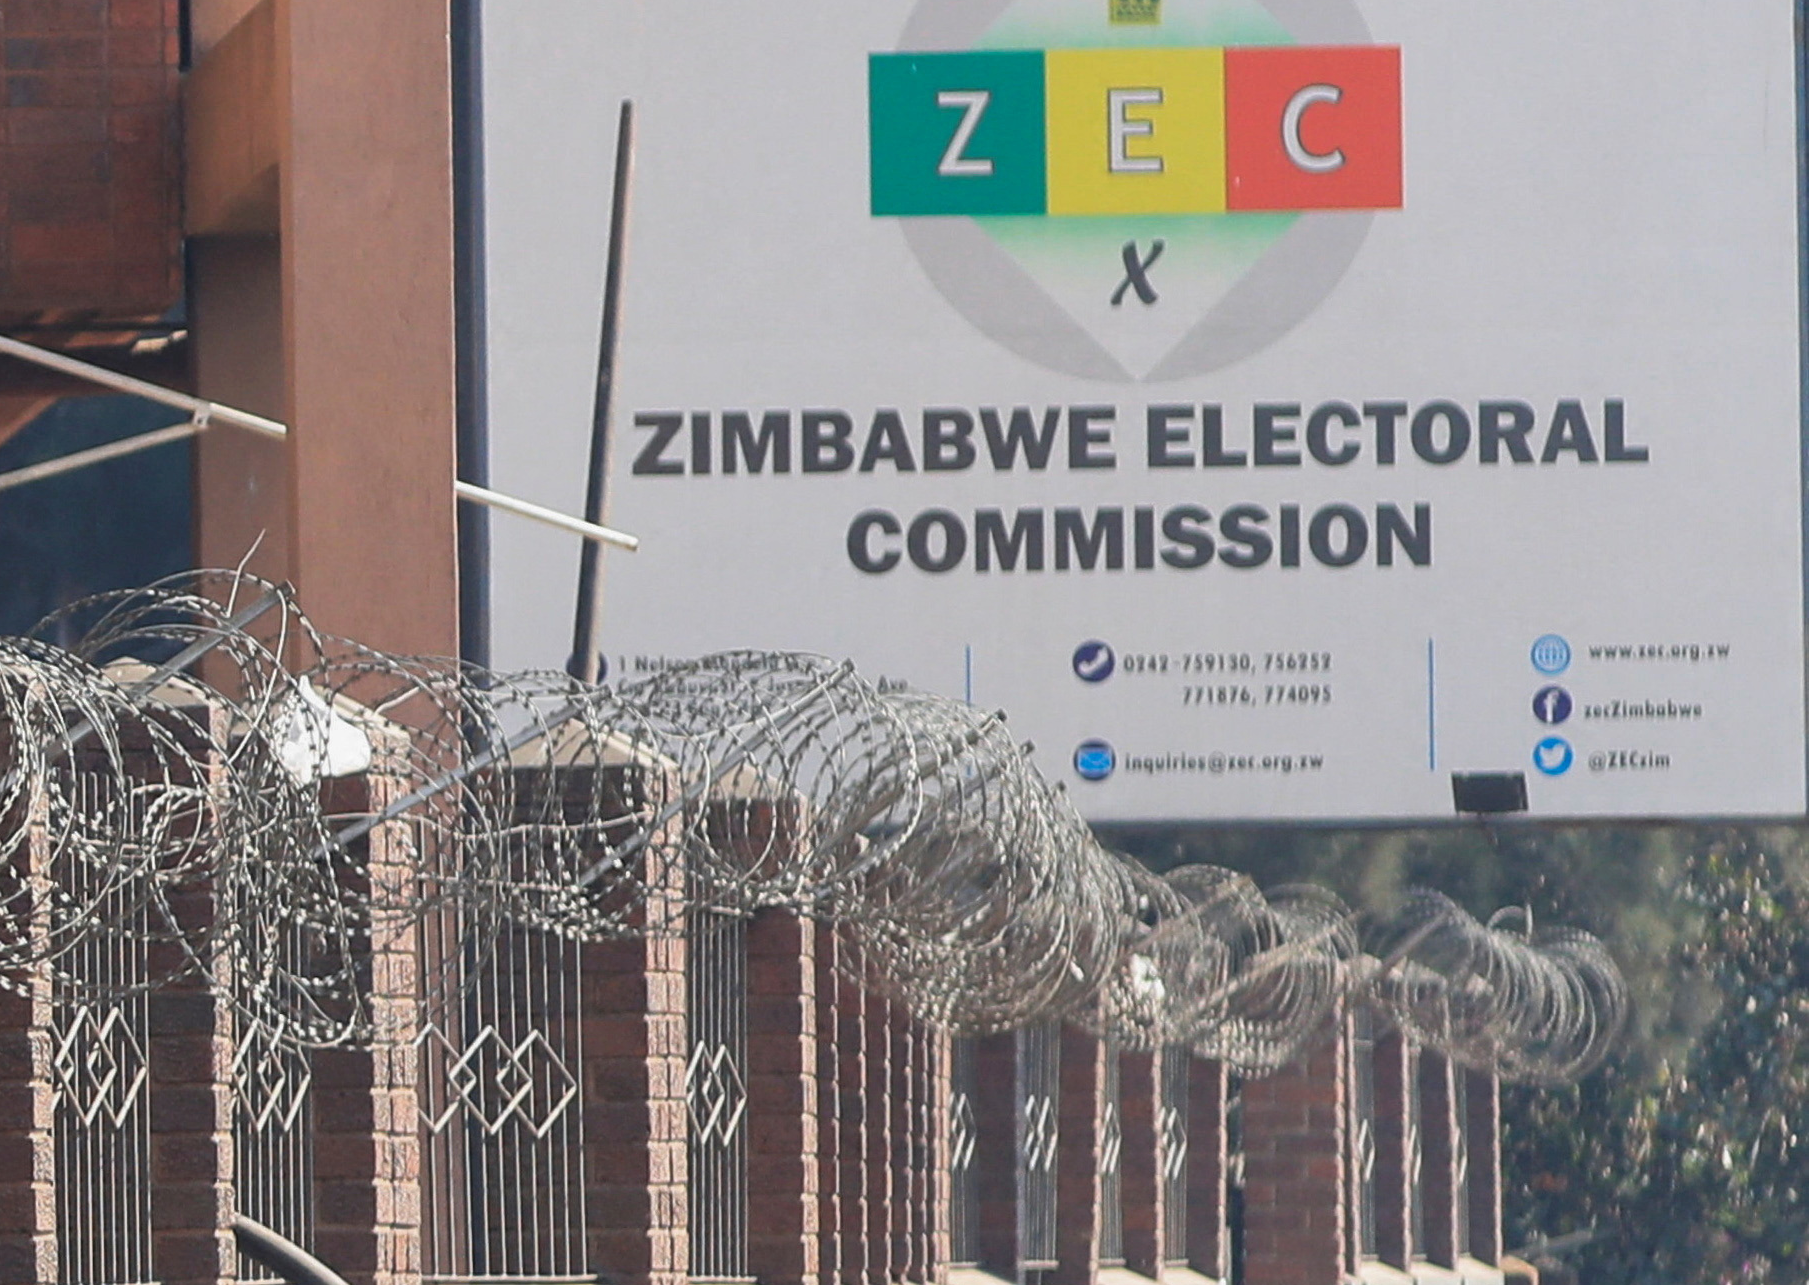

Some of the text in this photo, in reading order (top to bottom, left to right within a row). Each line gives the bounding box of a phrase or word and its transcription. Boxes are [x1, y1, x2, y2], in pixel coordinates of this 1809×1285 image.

[630, 399, 1651, 477] ZIMBABWE ELECTORAL
[845, 502, 1433, 576] COMMISSION
[1264, 684, 1332, 704] 774095
